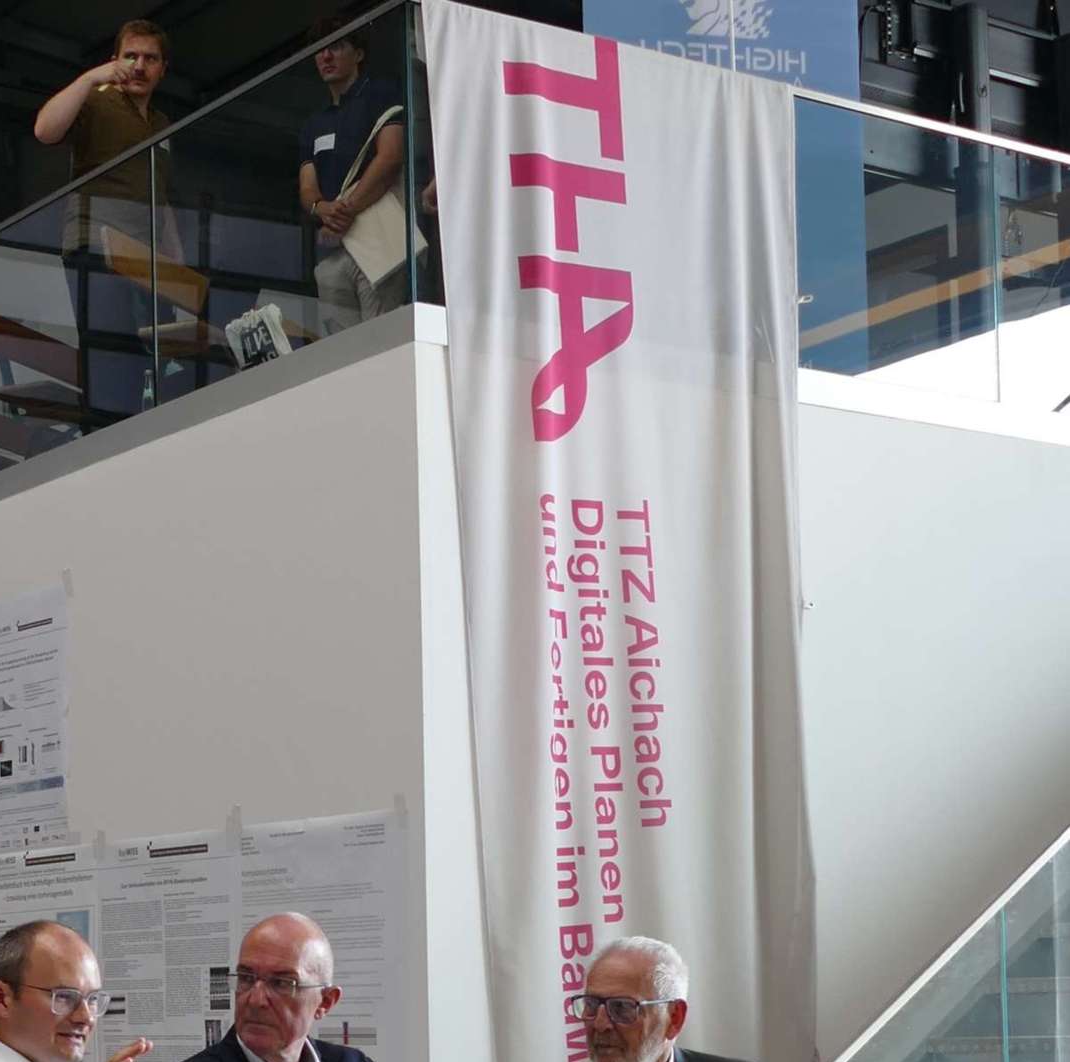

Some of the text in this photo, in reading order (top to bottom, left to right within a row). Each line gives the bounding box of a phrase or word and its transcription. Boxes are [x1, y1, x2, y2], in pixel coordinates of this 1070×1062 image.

[539, 493, 565, 593] und
[549, 608, 575, 832] Fertigen
[566, 499, 624, 924] Digitales Planen
[616, 499, 672, 828] TTZ Aichach
[555, 846, 586, 909] im
